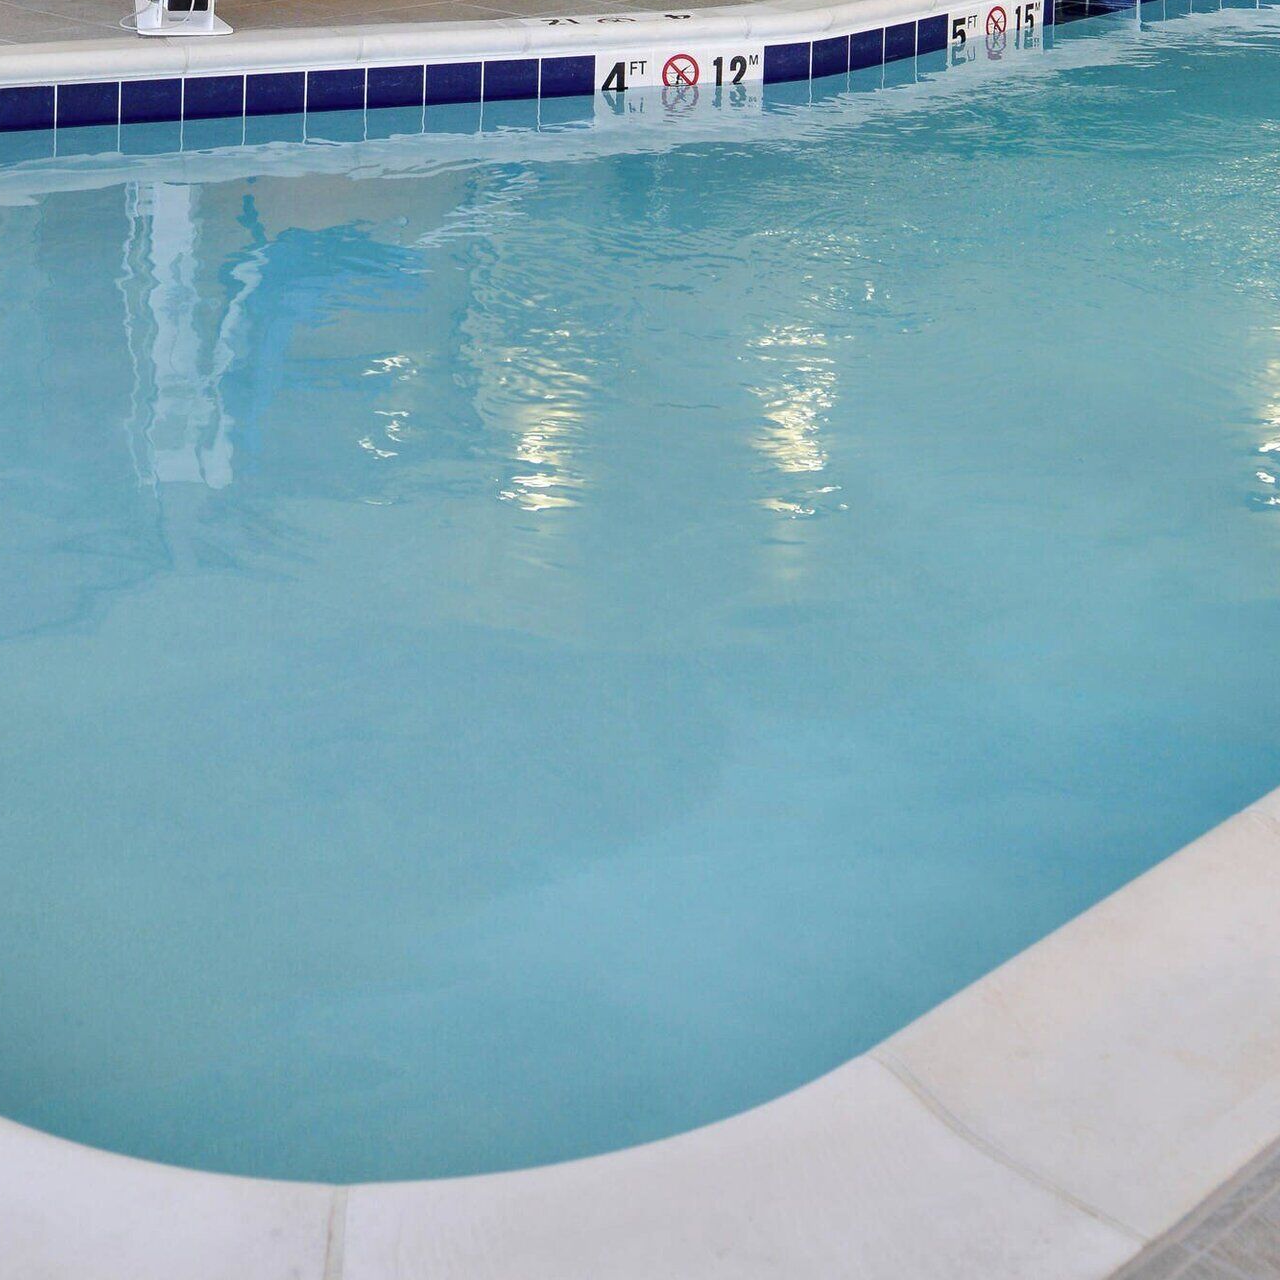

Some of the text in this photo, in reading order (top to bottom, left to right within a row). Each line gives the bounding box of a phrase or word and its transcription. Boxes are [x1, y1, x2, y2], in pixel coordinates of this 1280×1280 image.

[952, 1, 1041, 45] 5 FT 15 M
[601, 54, 759, 92] 4 FT 12 M
